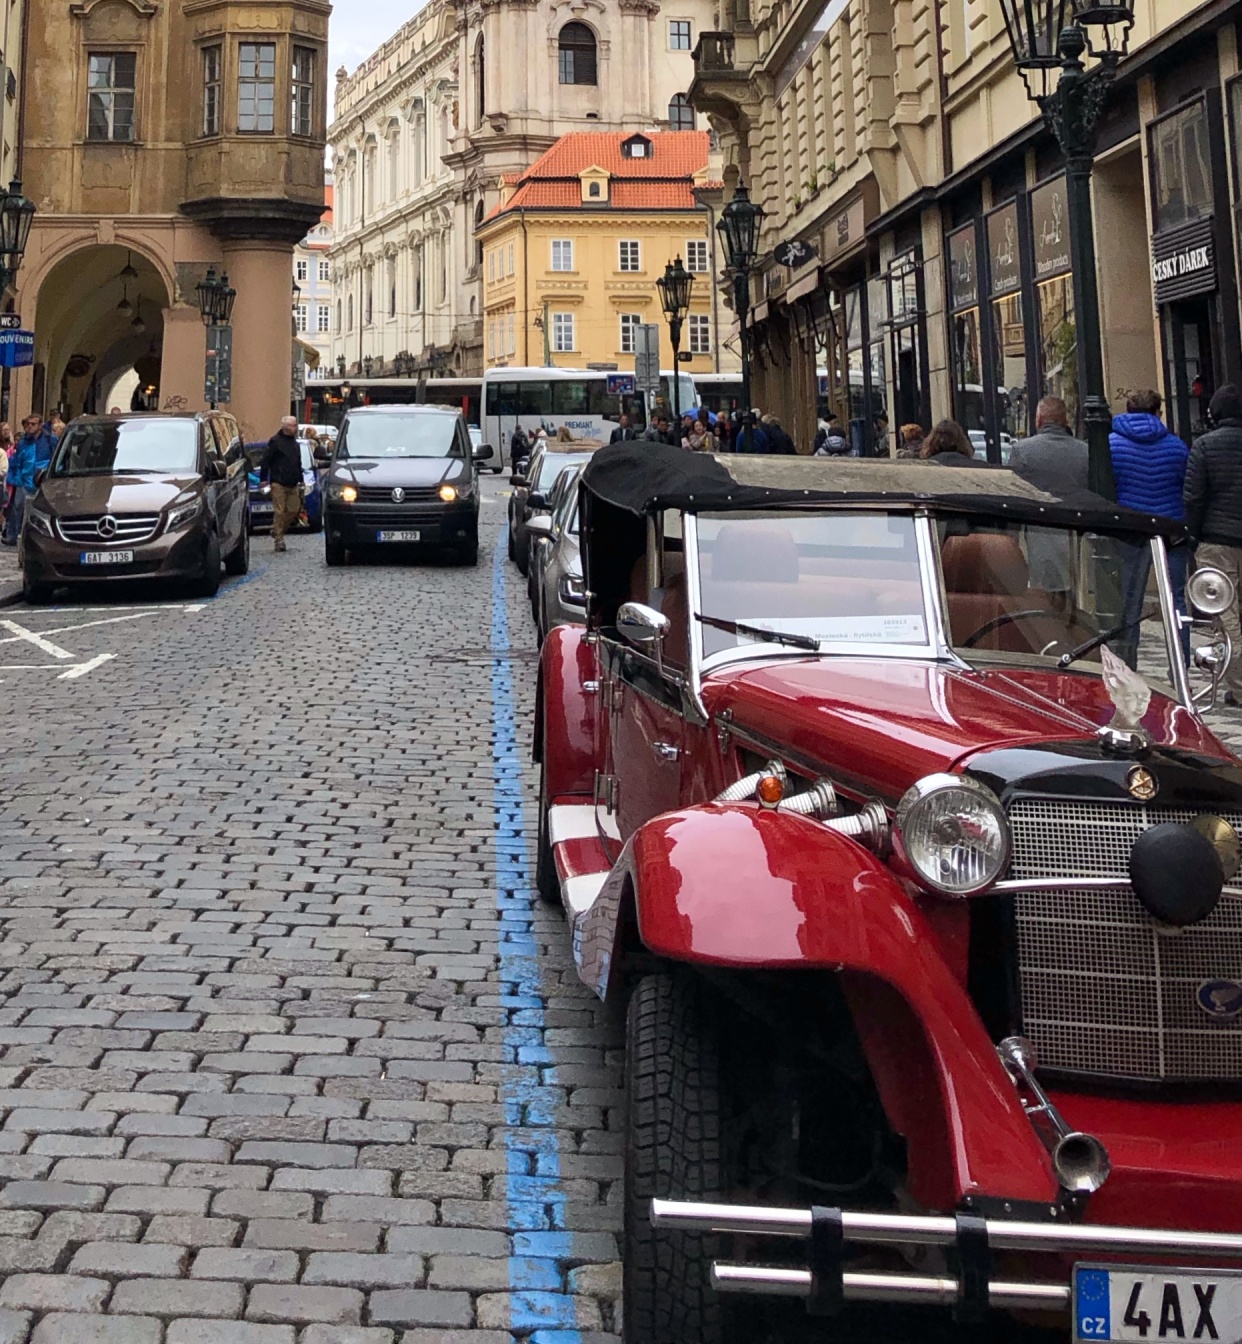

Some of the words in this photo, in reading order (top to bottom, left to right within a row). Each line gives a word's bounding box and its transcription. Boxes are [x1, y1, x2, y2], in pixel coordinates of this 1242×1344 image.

[1152, 251, 1178, 282] ČESKÝ
[1179, 246, 1209, 275] DÁREK
[1, 317, 12, 326] WC
[87, 553, 102, 563] 6AT
[108, 552, 129, 562] 3136
[1123, 1280, 1219, 1339] 4AX
[1082, 1316, 1106, 1334] CZ
